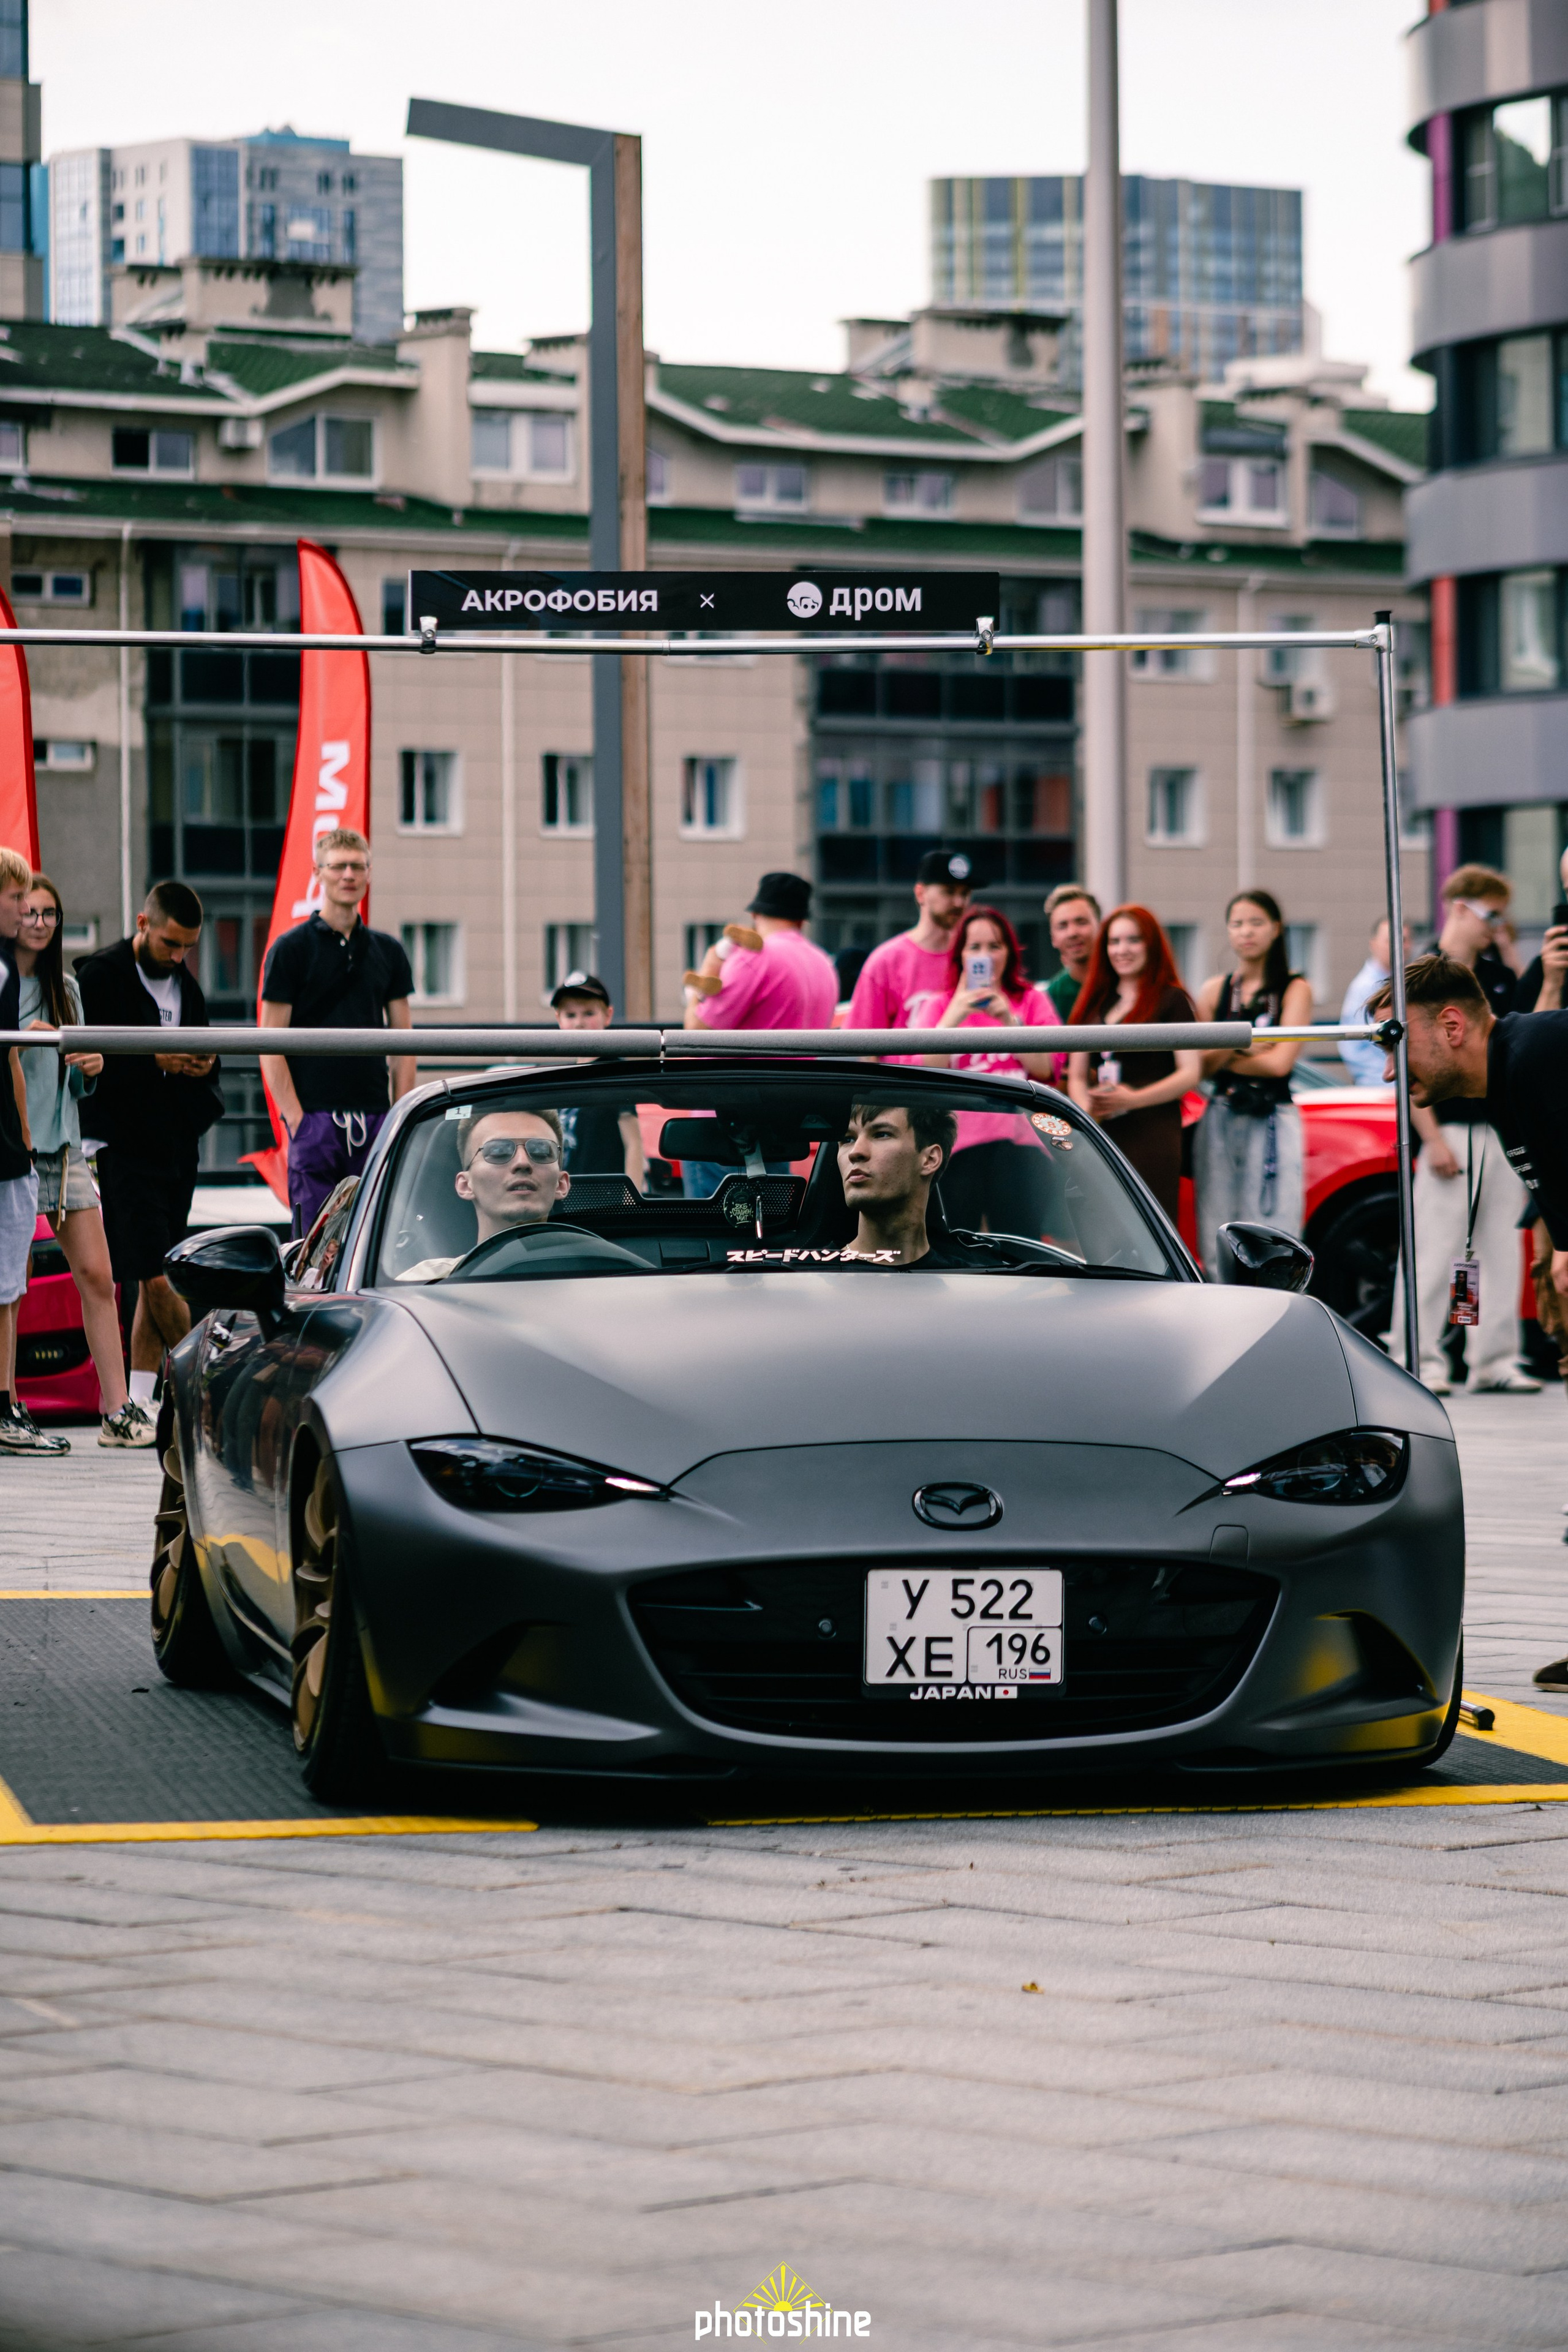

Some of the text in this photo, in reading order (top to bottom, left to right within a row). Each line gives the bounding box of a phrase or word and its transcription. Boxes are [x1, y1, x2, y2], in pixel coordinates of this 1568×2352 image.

[461, 589, 658, 612] АКРОФОБИЯ
[726, 1250, 901, 1263] スピードハンターズ
[951, 1578, 1033, 1620] 522
[986, 1633, 1050, 1665] 196
[998, 1668, 1027, 1679] RUS
[910, 1686, 992, 1700] JAPAN
